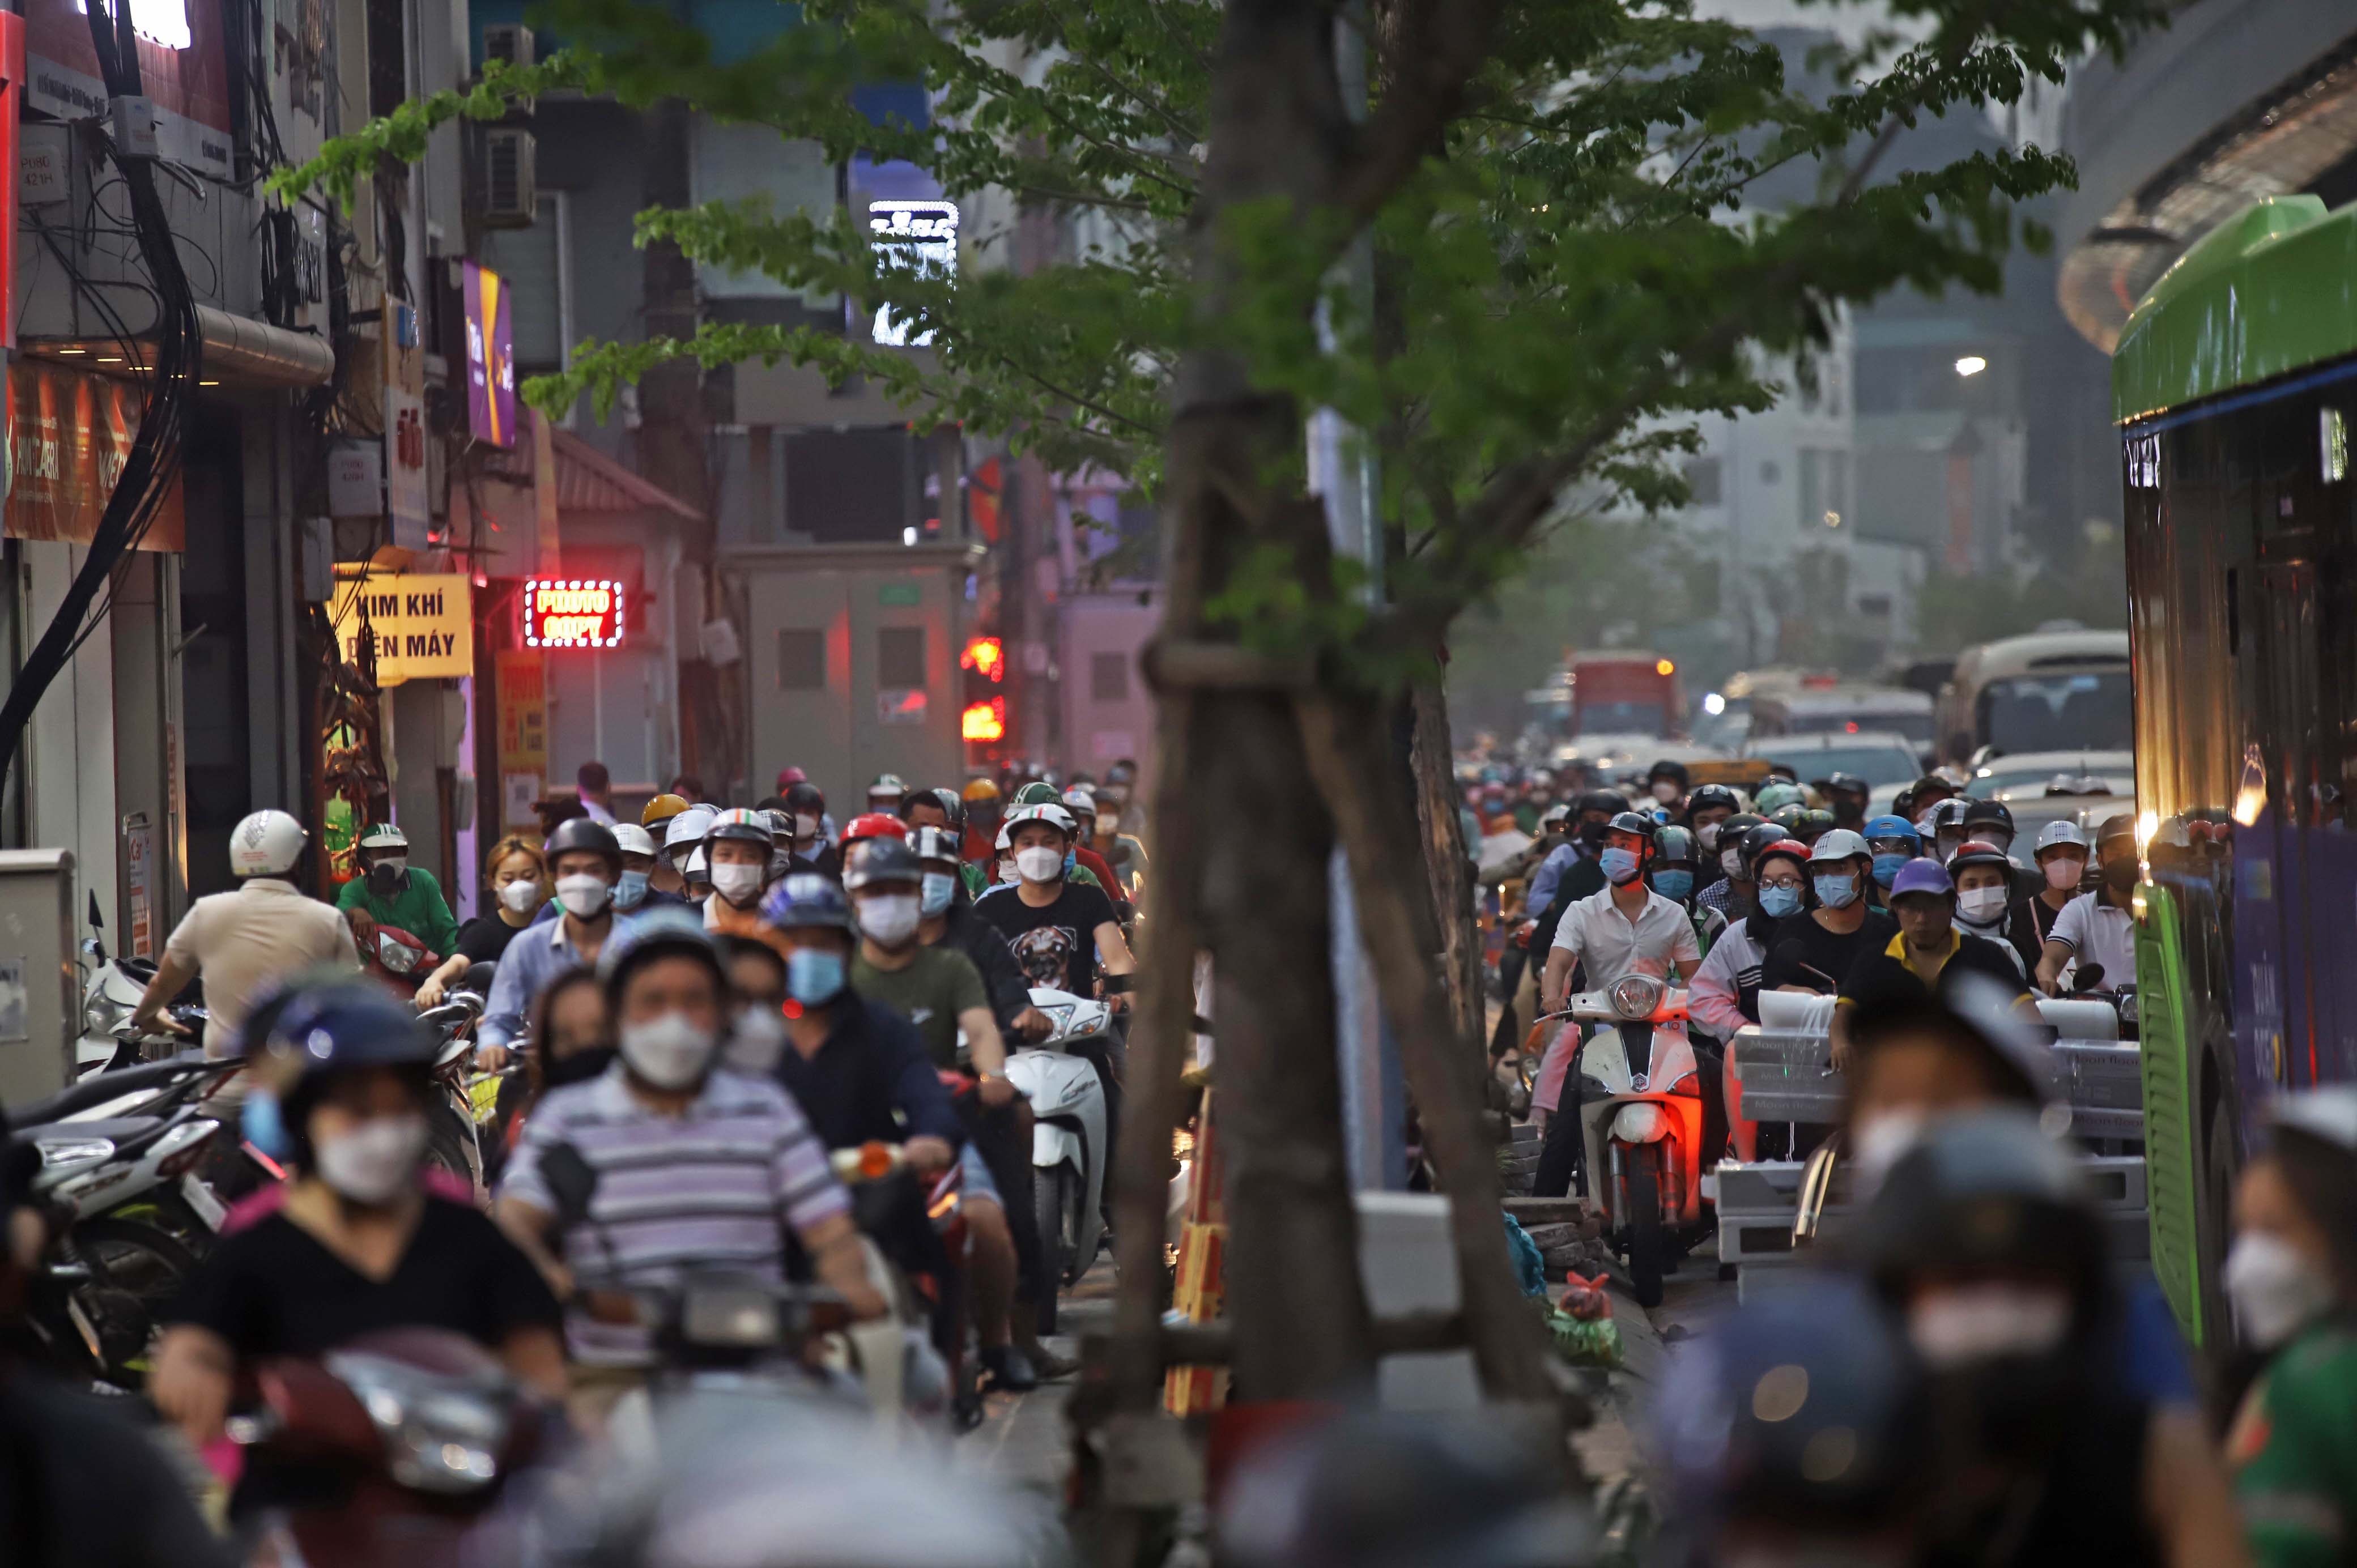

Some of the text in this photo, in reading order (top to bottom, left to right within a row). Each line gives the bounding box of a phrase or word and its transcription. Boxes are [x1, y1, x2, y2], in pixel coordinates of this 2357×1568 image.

[355, 587, 443, 616] KIM KHÍ
[537, 589, 610, 614] PHOTO
[543, 615, 603, 640] COPY
[347, 629, 454, 658] ĐỆN MÁY
